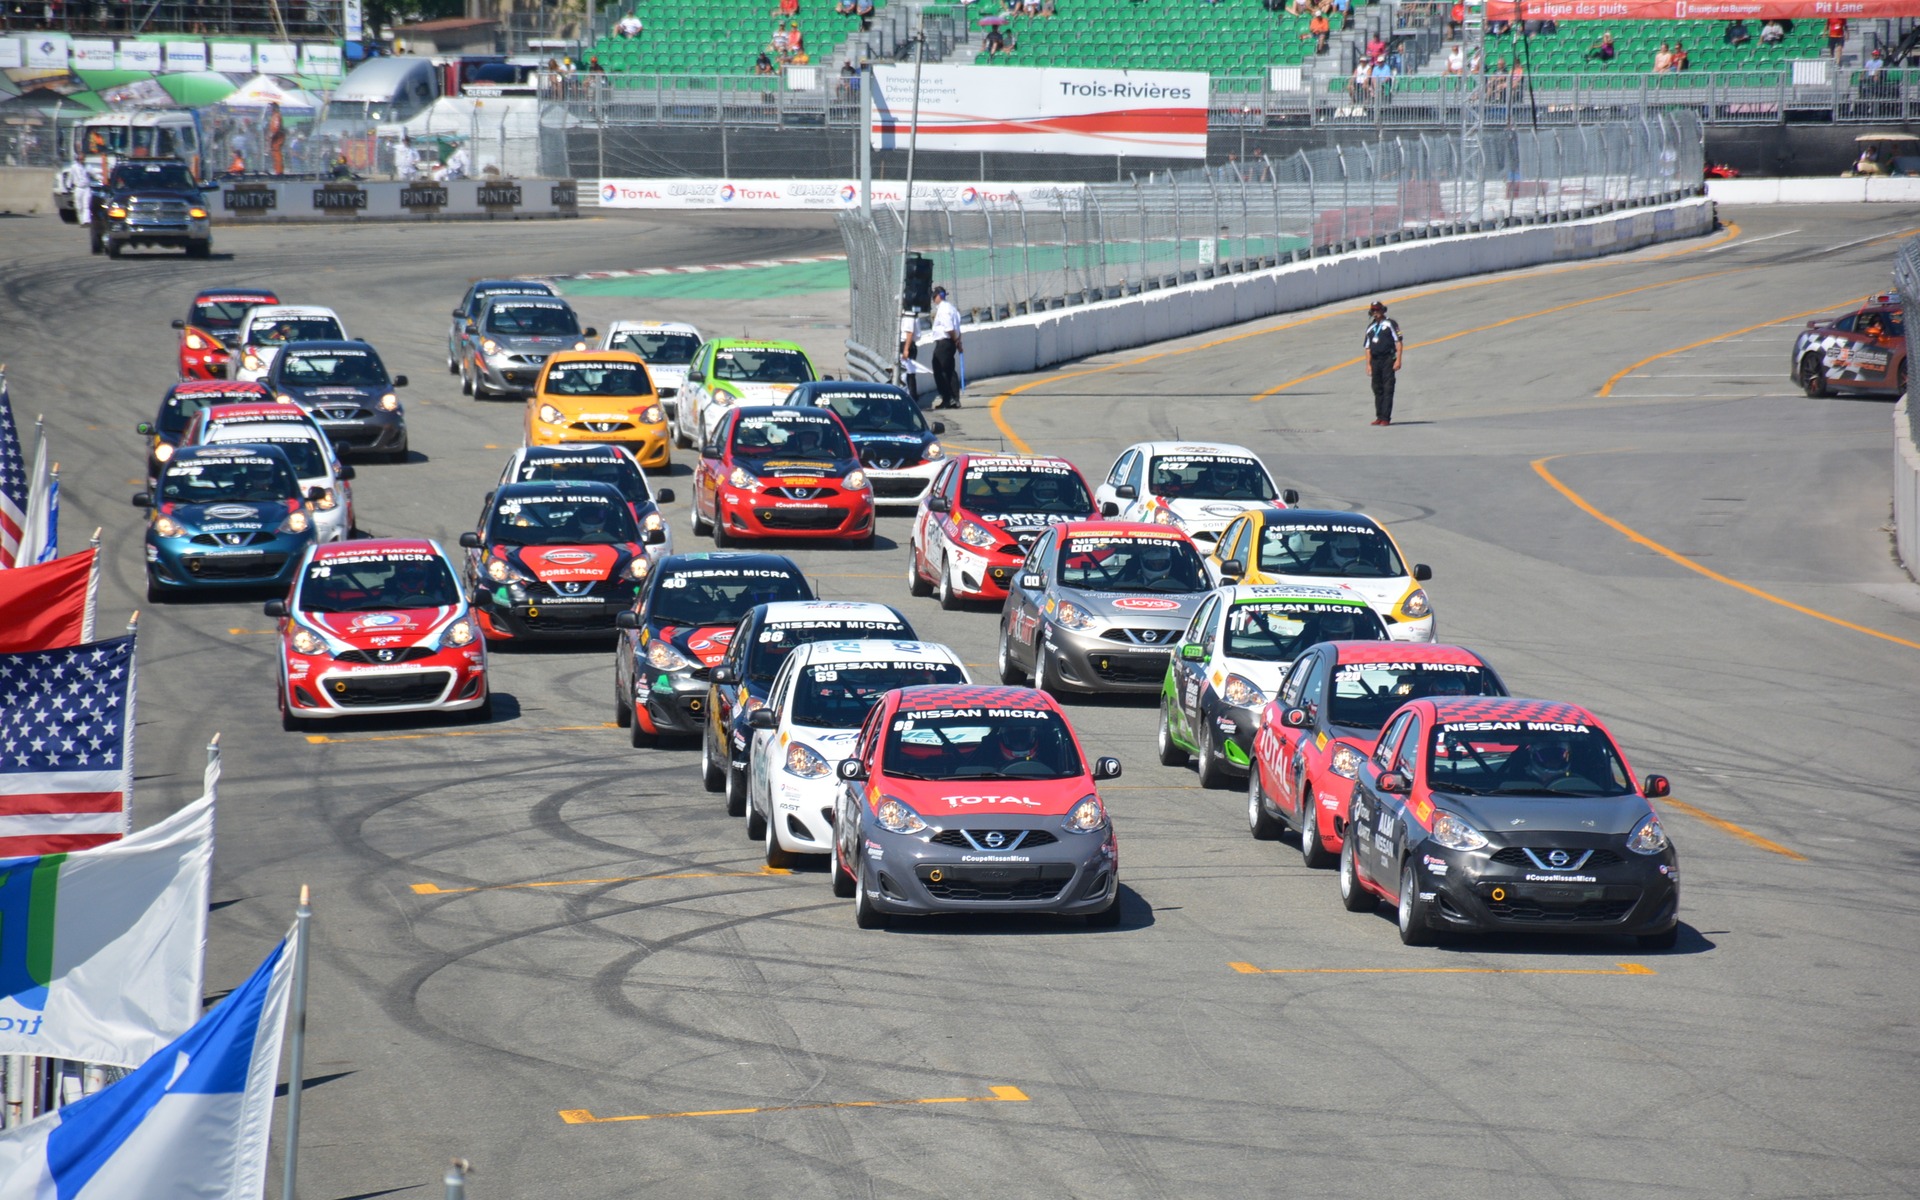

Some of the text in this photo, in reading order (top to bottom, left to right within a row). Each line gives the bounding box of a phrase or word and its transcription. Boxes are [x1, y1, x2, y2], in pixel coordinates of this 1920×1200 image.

[1527, 3, 1628, 16] La ligne des puits
[1816, 2, 1864, 13] Pit Lane
[886, 76, 931, 84] Innovaon
[886, 85, 956, 95] Dévelopement
[1060, 81, 1191, 99] Trois-Rivières
[885, 96, 941, 104] éconoique
[226, 192, 276, 207] PINTY'S
[315, 192, 367, 207] PINTY'S
[402, 191, 447, 205] PINTY'S
[478, 190, 520, 203] PINTY'S
[559, 363, 636, 371] NISSAN MICRA
[175, 391, 262, 400] NISSAN MICRA
[214, 415, 264, 425] NISSAN
[744, 416, 831, 425] NISSAN MICRA
[215, 437, 268, 445] NISSAN
[176, 457, 275, 468] NISSAN MICRA
[529, 456, 626, 466] NISSAN MICRA
[1216, 456, 1254, 465] MICRA
[522, 467, 536, 480] 7
[1030, 466, 1069, 475] MICRA
[505, 495, 609, 506] NISSAN MICRA
[1269, 524, 1375, 535] NISSAN MICRA
[1136, 538, 1181, 547] MICRA
[320, 554, 435, 567] NISSAN MICRA
[540, 568, 604, 577] SOREL-TRACY
[674, 569, 790, 579] NISSAN MICRA
[662, 578, 687, 589] 40
[541, 596, 605, 604] #CoupeNissanMicra
[1123, 599, 1173, 608] Lloyds
[1240, 603, 1363, 615] NISSAN MICRA
[771, 621, 897, 631] NISSAN MICRA
[1229, 611, 1246, 631] 11
[758, 632, 784, 643] 86
[814, 662, 947, 672] NISSAN MICRA
[1345, 663, 1480, 674] NISSAN MICRA
[815, 671, 838, 682] 69
[907, 708, 1049, 720] NISSAN MICRA
[1443, 722, 1590, 734] NISSAN MICRA
[1437, 732, 1446, 743] 1
[940, 795, 1042, 807] TOTAL
[961, 855, 1030, 863] #CoupeNissanMicra
[1525, 874, 1597, 883] #CoupeNissanMicra
